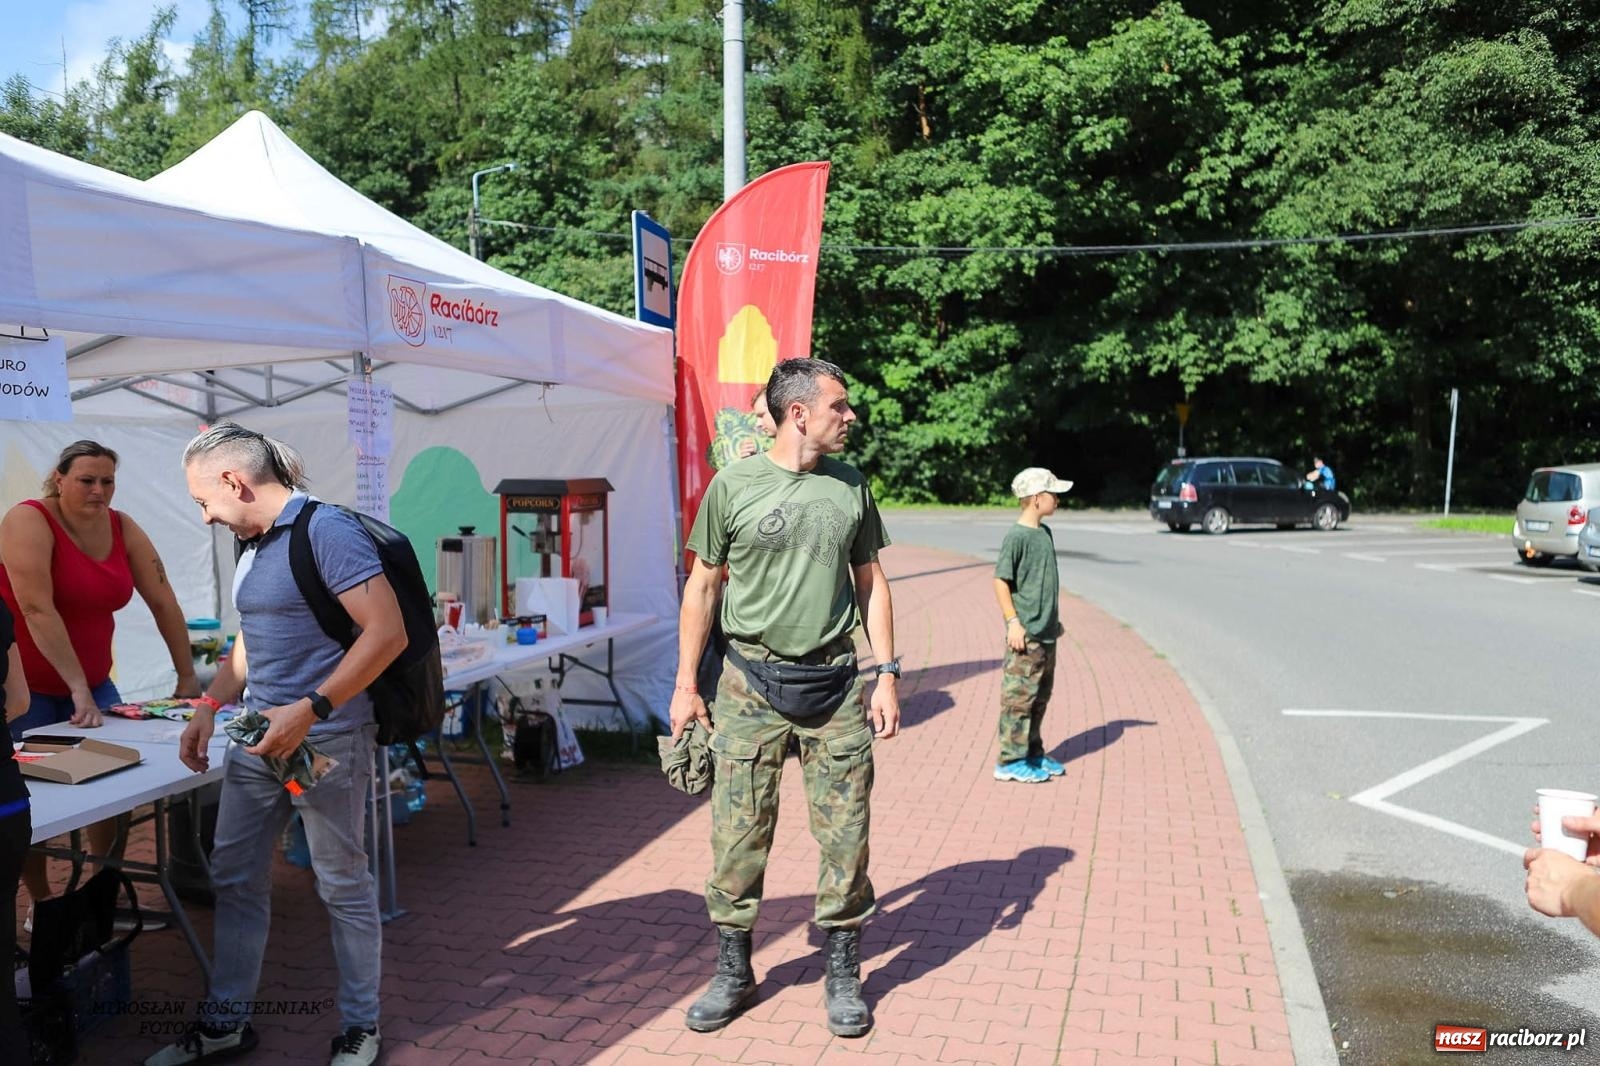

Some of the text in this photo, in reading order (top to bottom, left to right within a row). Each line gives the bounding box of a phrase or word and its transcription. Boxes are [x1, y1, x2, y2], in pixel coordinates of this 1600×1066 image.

[749, 248, 809, 263] Racibórz
[430, 293, 498, 327] Racibórz
[432, 325, 453, 344] 1217
[0, 381, 49, 397] ODÓW
[512, 497, 554, 508] POPCORN
